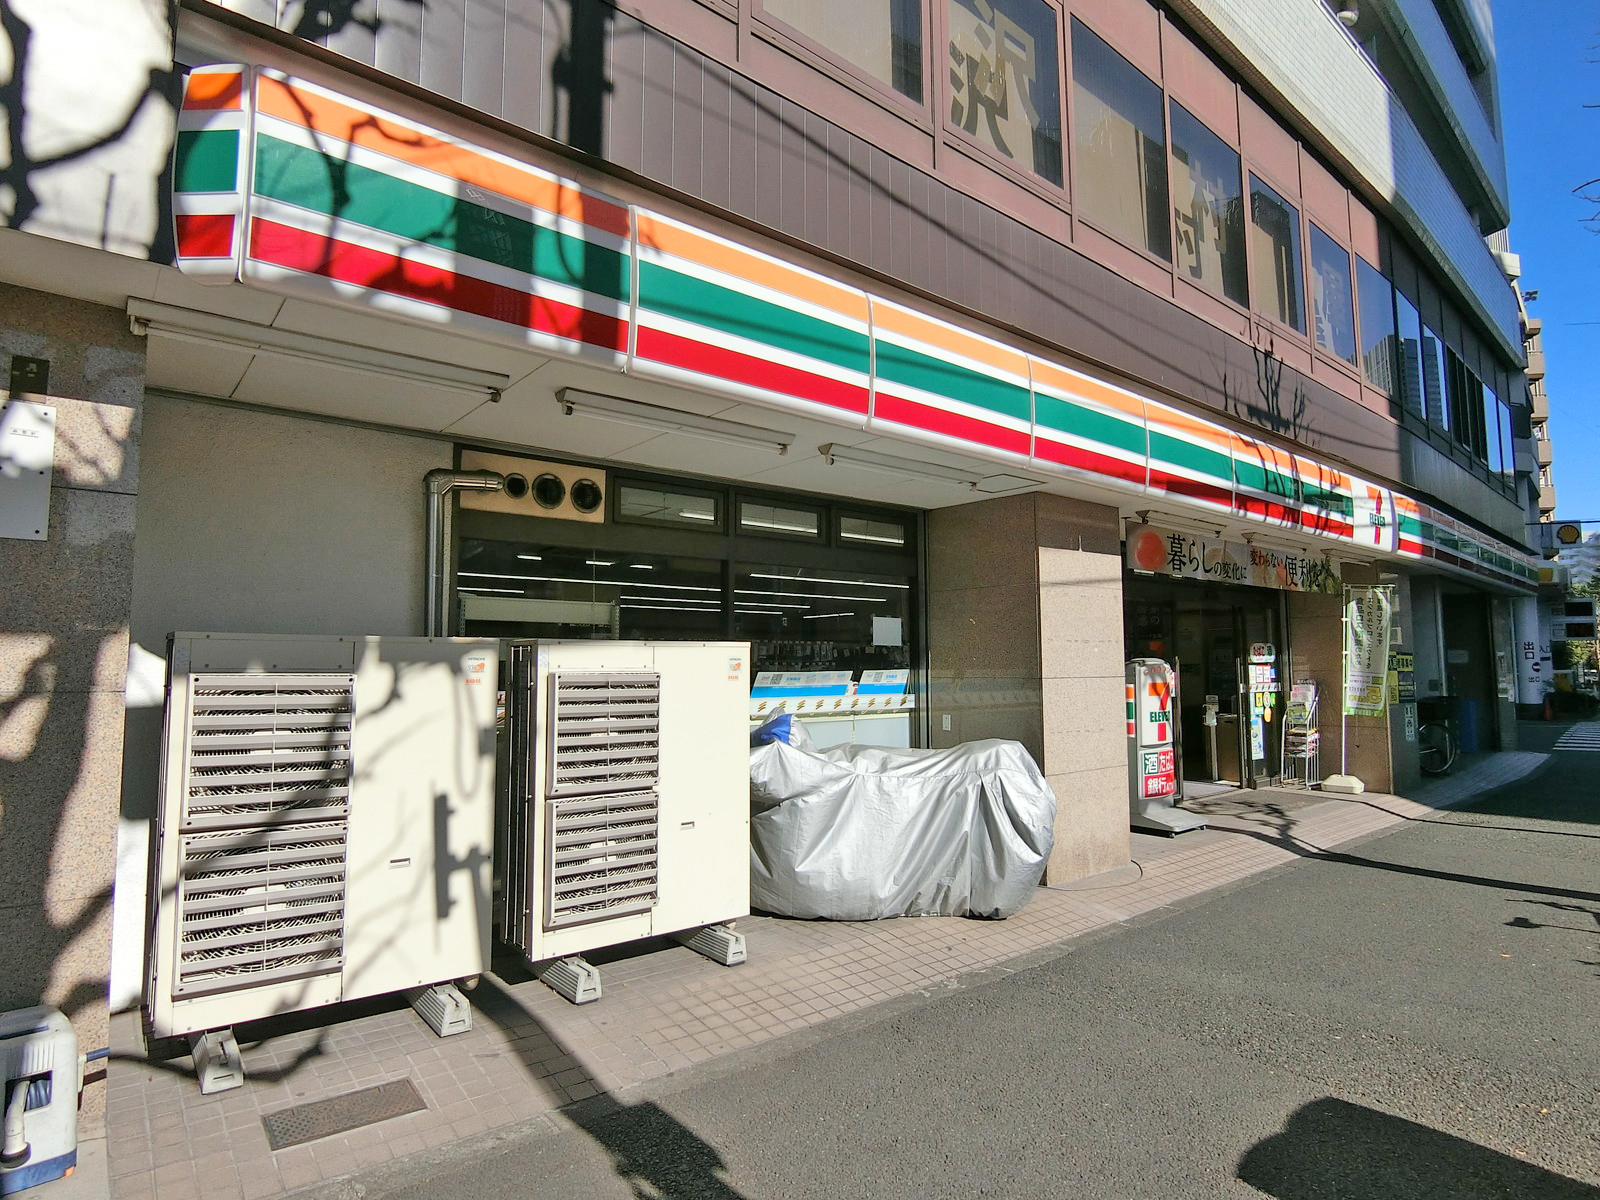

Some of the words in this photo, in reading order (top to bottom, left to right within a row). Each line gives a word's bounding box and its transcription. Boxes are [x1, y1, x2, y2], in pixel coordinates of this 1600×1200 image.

[1166, 533, 1248, 581] 暮らしの変化に
[1523, 641, 1535, 660] 出口
[1145, 753, 1158, 774] 酒
[1147, 776, 1167, 795] 銀行
